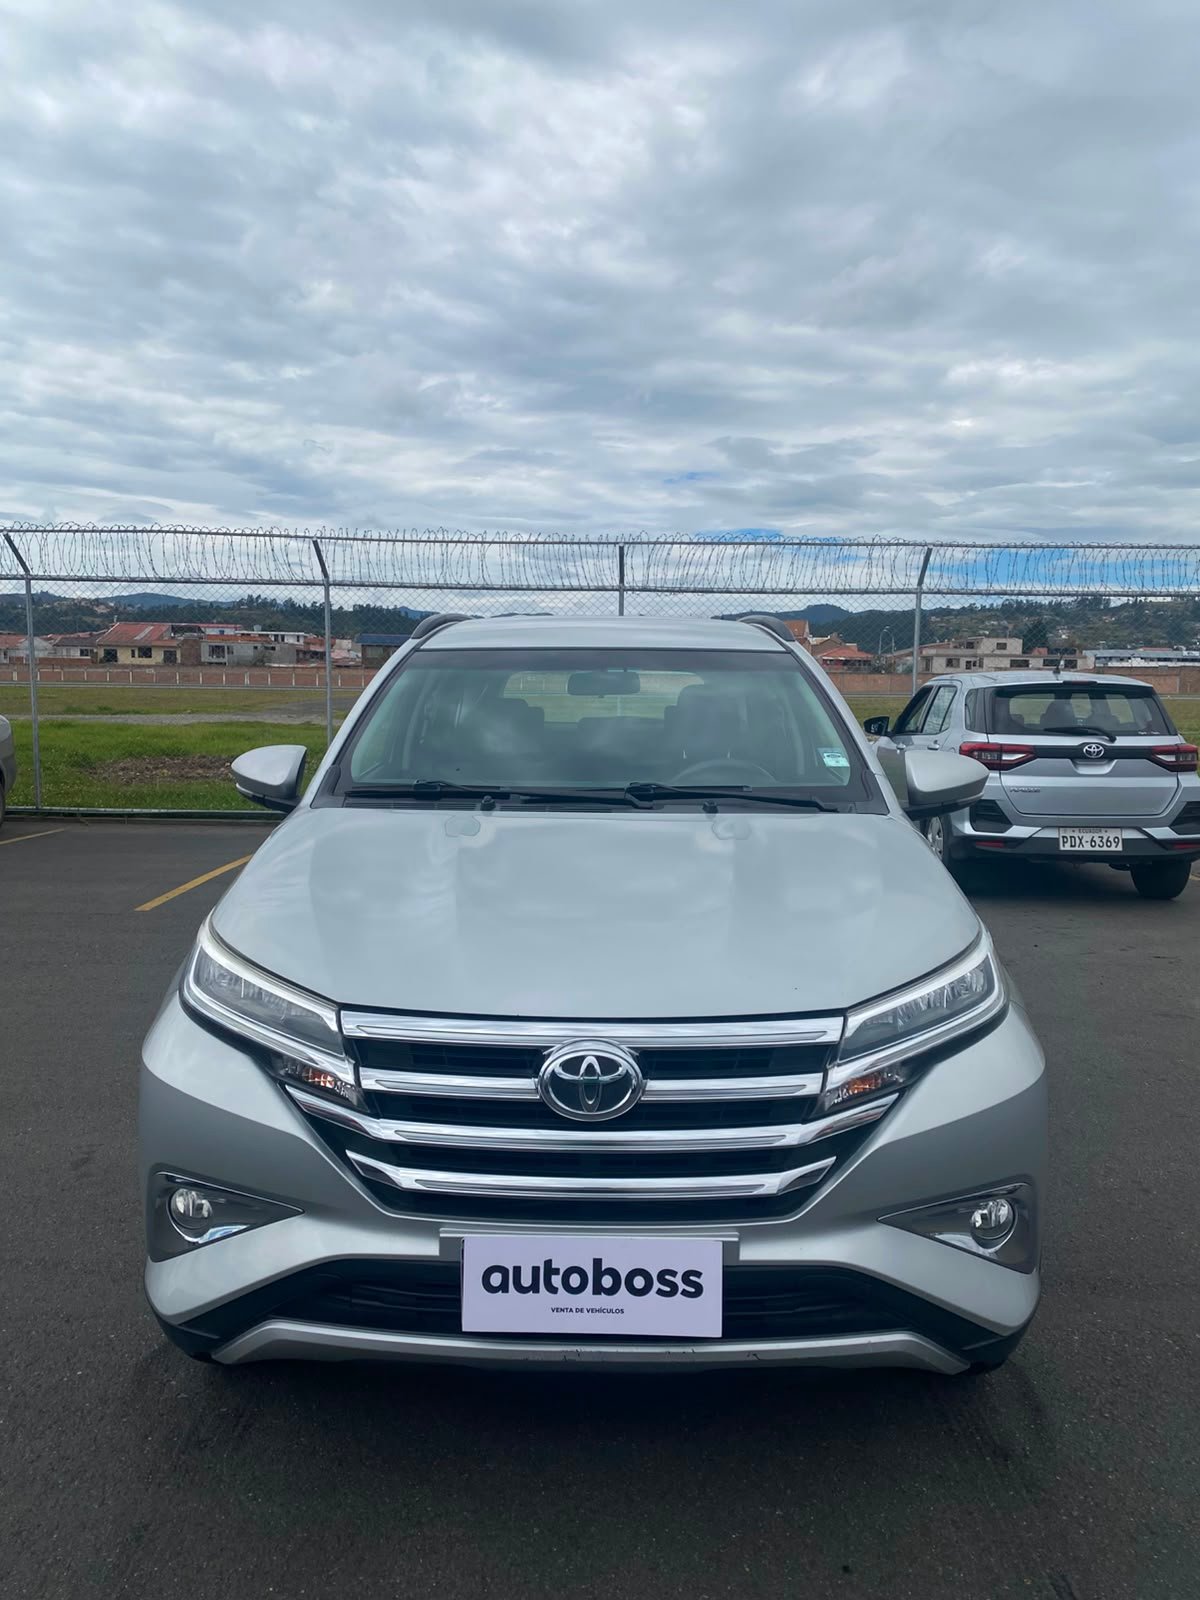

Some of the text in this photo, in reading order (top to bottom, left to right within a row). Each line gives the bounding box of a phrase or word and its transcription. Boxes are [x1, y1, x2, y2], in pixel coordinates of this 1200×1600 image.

[1061, 835, 1120, 848] PDX-6369
[481, 1257, 704, 1299] autoboss
[586, 1306, 625, 1315] VEHÍCULOS
